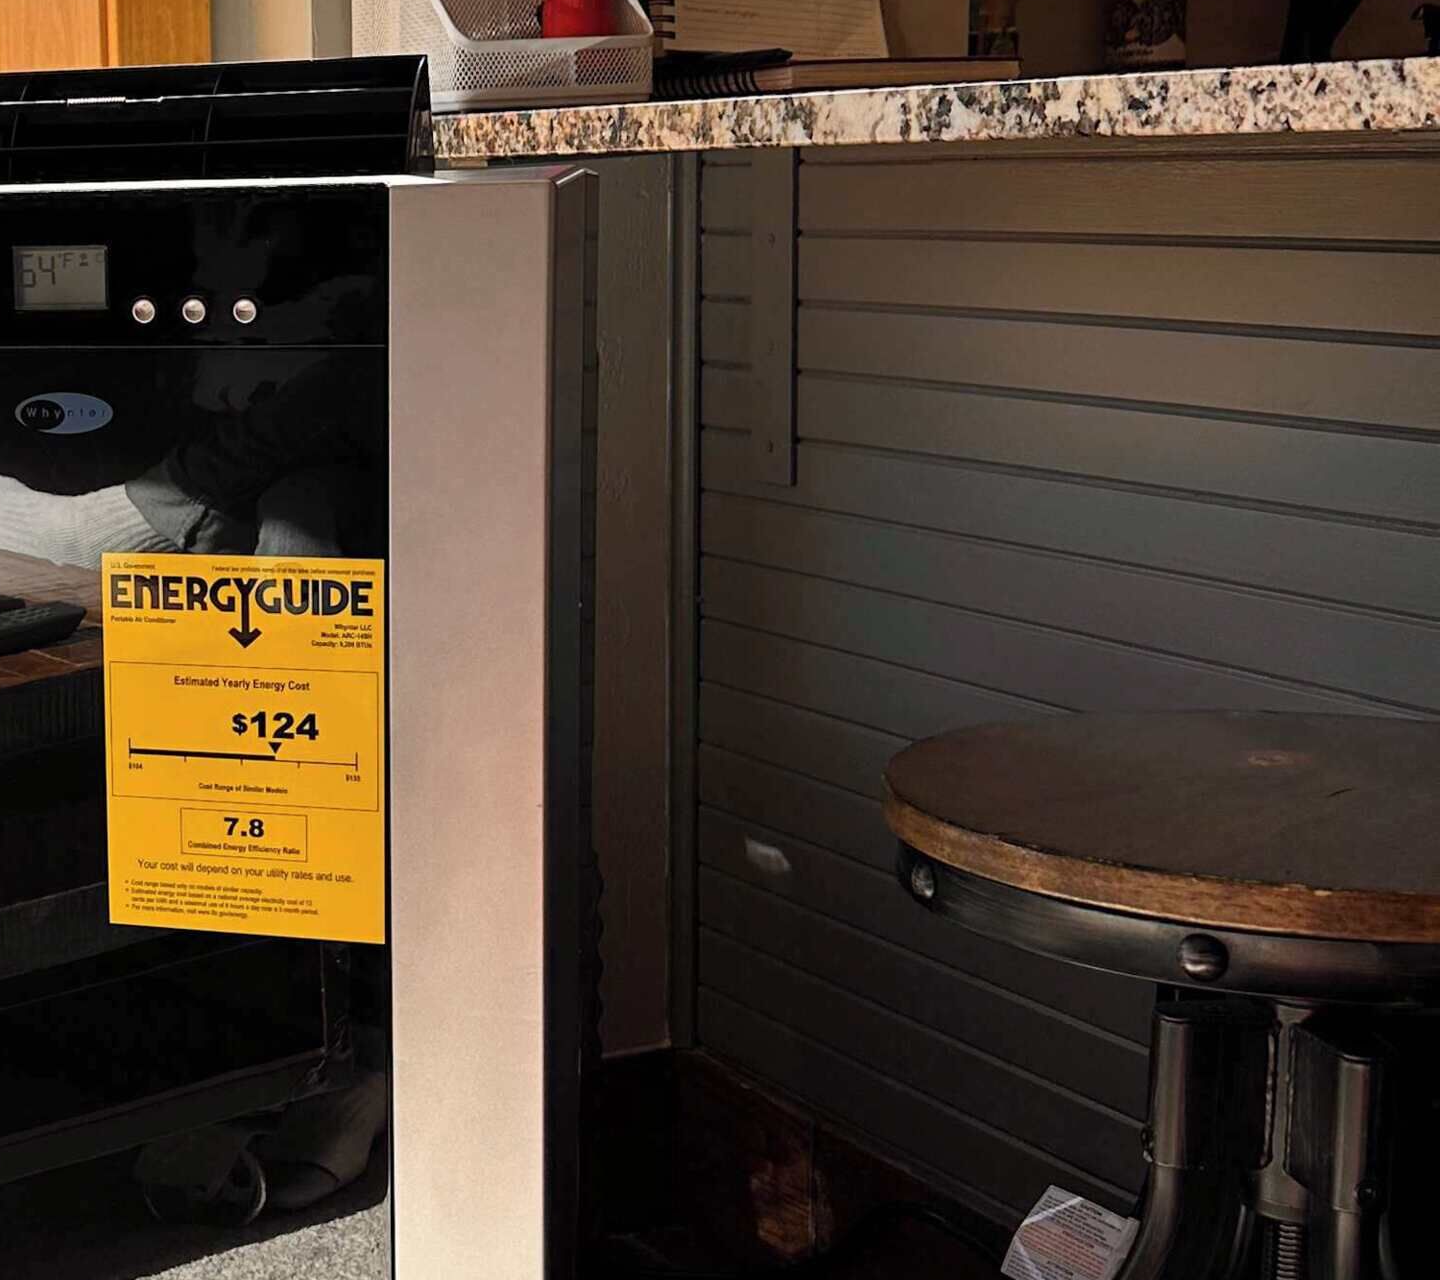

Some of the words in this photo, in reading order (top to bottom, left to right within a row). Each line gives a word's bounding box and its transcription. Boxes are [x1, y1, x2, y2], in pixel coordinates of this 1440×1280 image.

[110, 574, 374, 617] ENERGYGUIDE
[174, 676, 219, 687] Estimated
[222, 678, 250, 691] Yearly
[253, 679, 285, 692] Energy
[288, 680, 310, 691] Cost
[232, 711, 319, 741] $124
[198, 782, 213, 791] Cost
[214, 783, 234, 793] Range
[235, 783, 242, 792] of
[243, 785, 264, 793] Similar
[265, 786, 288, 794] Models
[223, 817, 265, 838] 7.8
[188, 840, 222, 850] Combined
[223, 842, 247, 853] Energy
[248, 844, 282, 855] Efficiency
[283, 846, 301, 855] Ratio
[138, 858, 158, 870] Your
[160, 861, 179, 871] cost
[180, 862, 194, 872] will
[196, 863, 229, 875] depend
[230, 867, 242, 875] on
[245, 868, 264, 878] your
[266, 868, 289, 880] utility
[291, 871, 313, 881] rates
[315, 871, 333, 881] and
